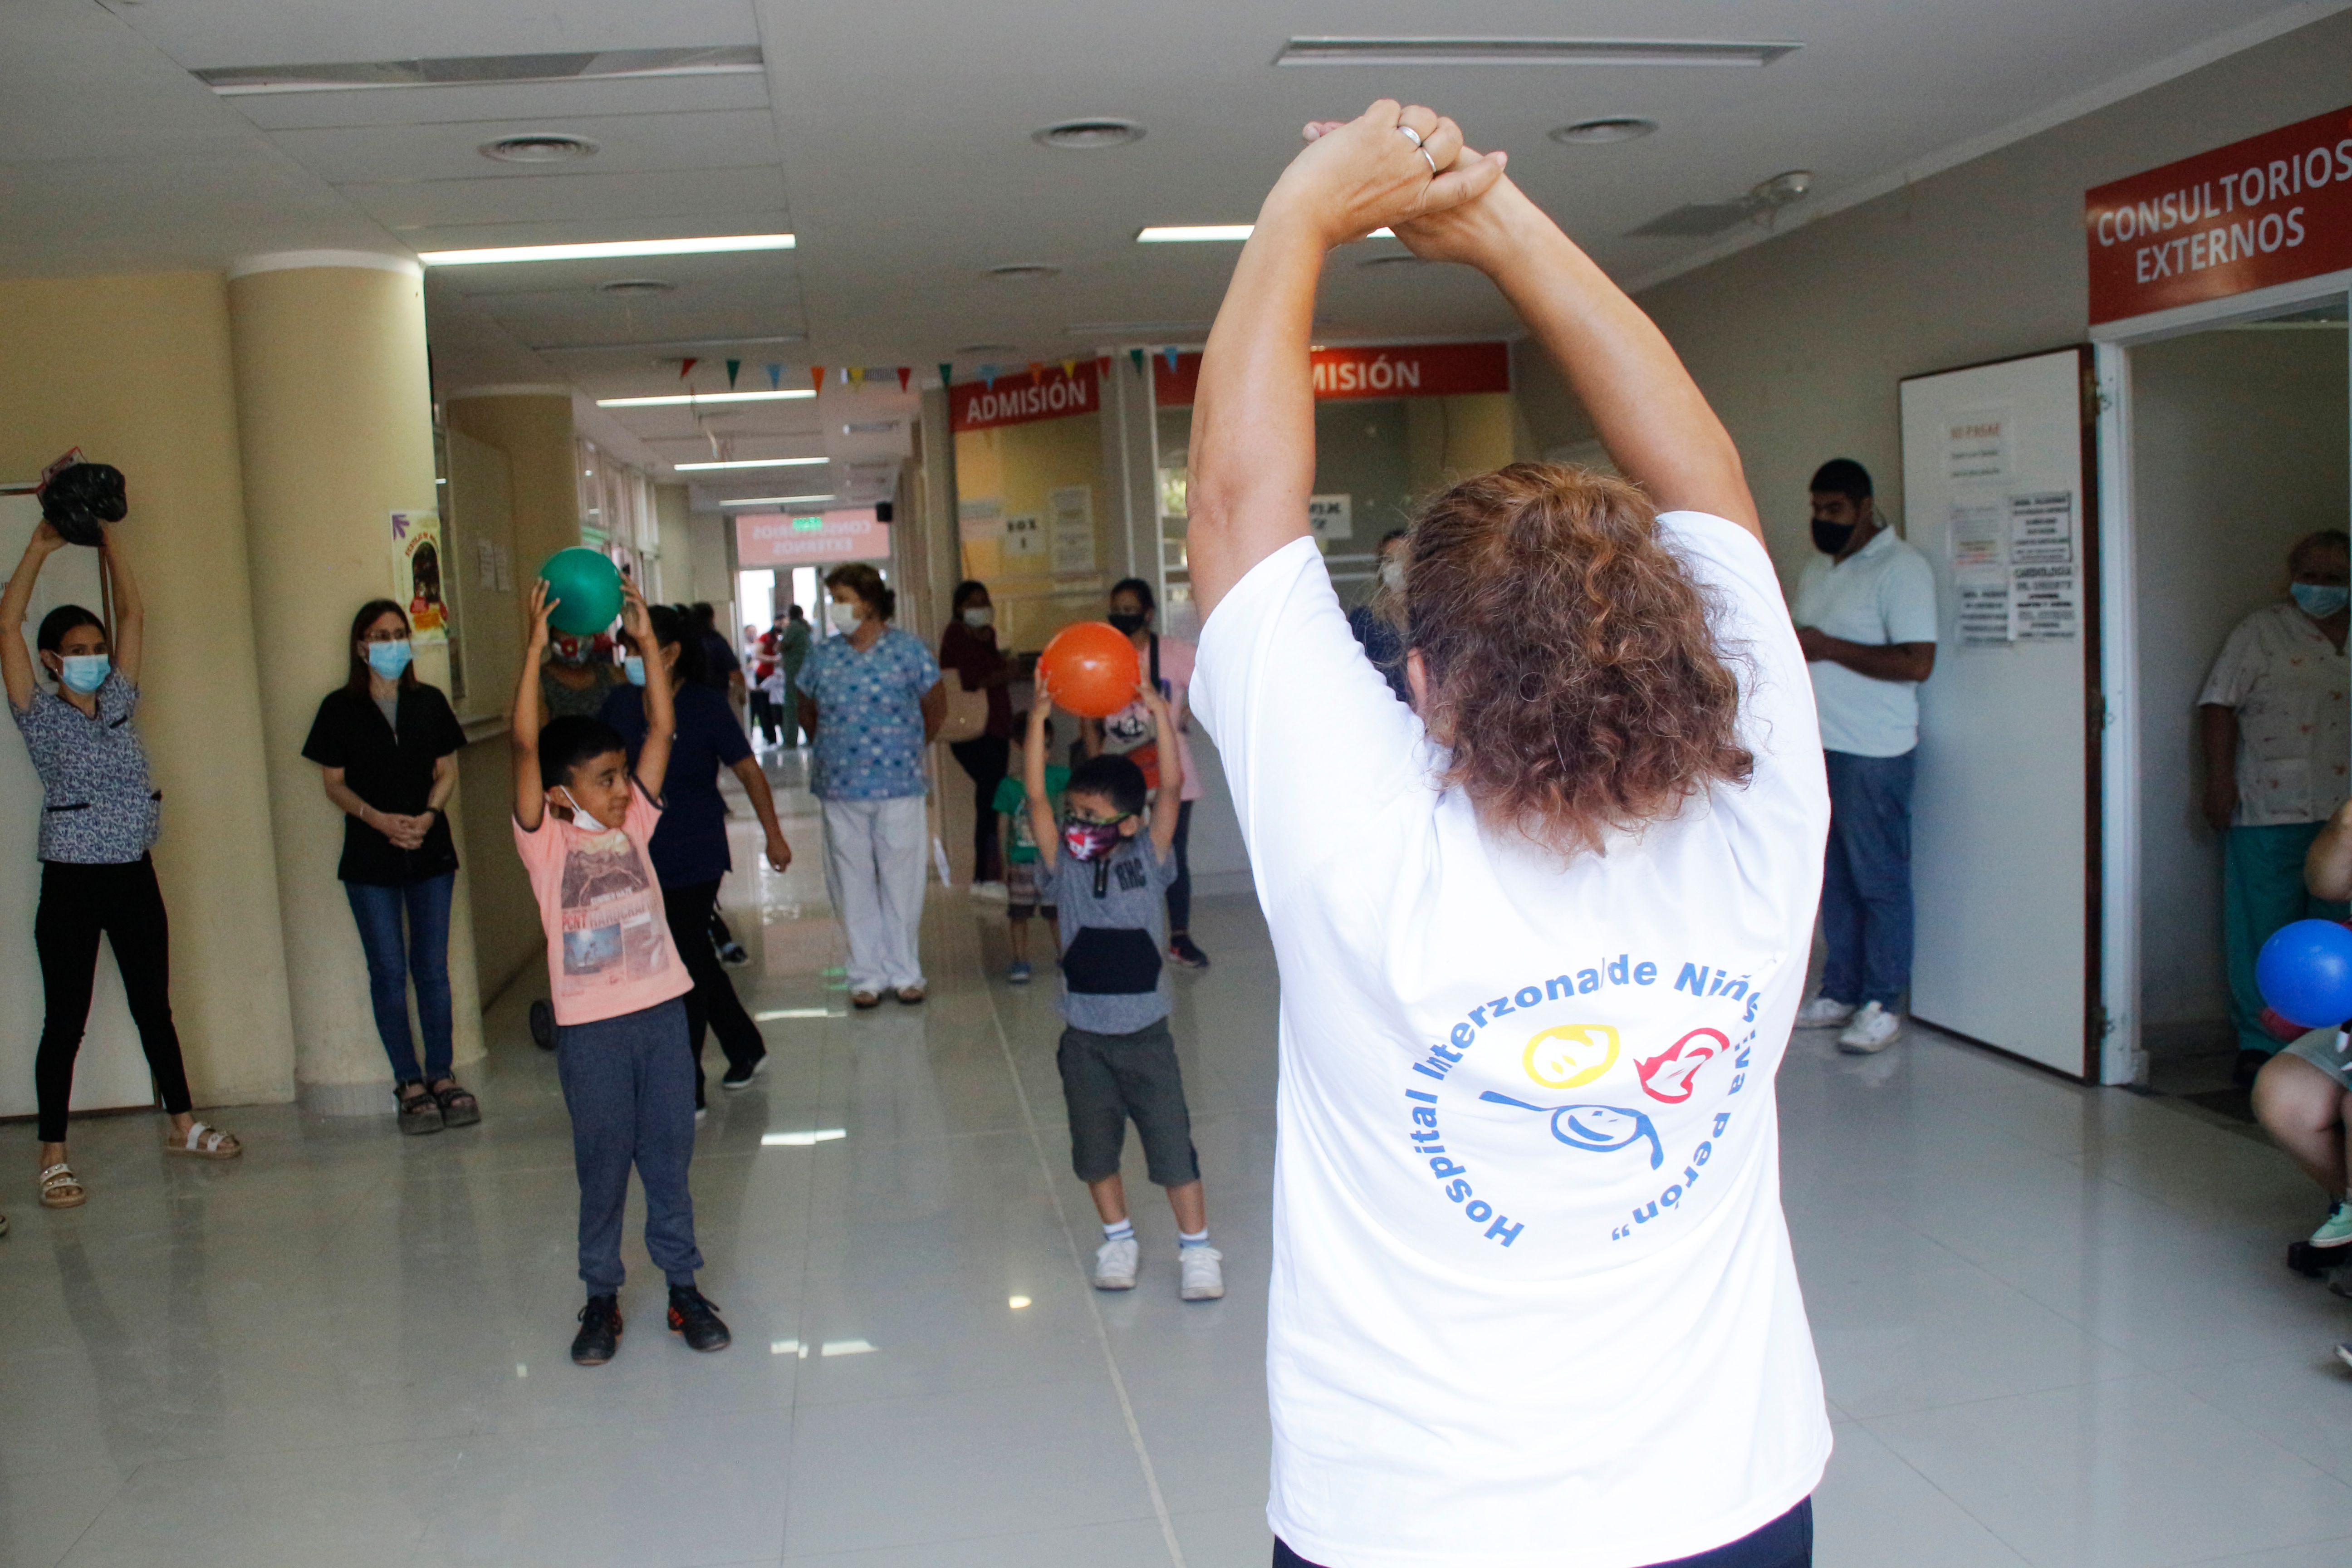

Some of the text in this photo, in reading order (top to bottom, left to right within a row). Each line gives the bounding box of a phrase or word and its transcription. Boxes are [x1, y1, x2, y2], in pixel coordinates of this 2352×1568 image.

[2097, 138, 2352, 247] CONSULTORIOS
[2136, 206, 2305, 284] EXTERNOS
[966, 374, 1087, 424] ADMISIÓN
[1313, 353, 1421, 392] MISIÓN
[1607, 954, 1657, 985] de
[1412, 957, 1605, 1081] Interzona
[1405, 1089, 1525, 1248] Hospital
